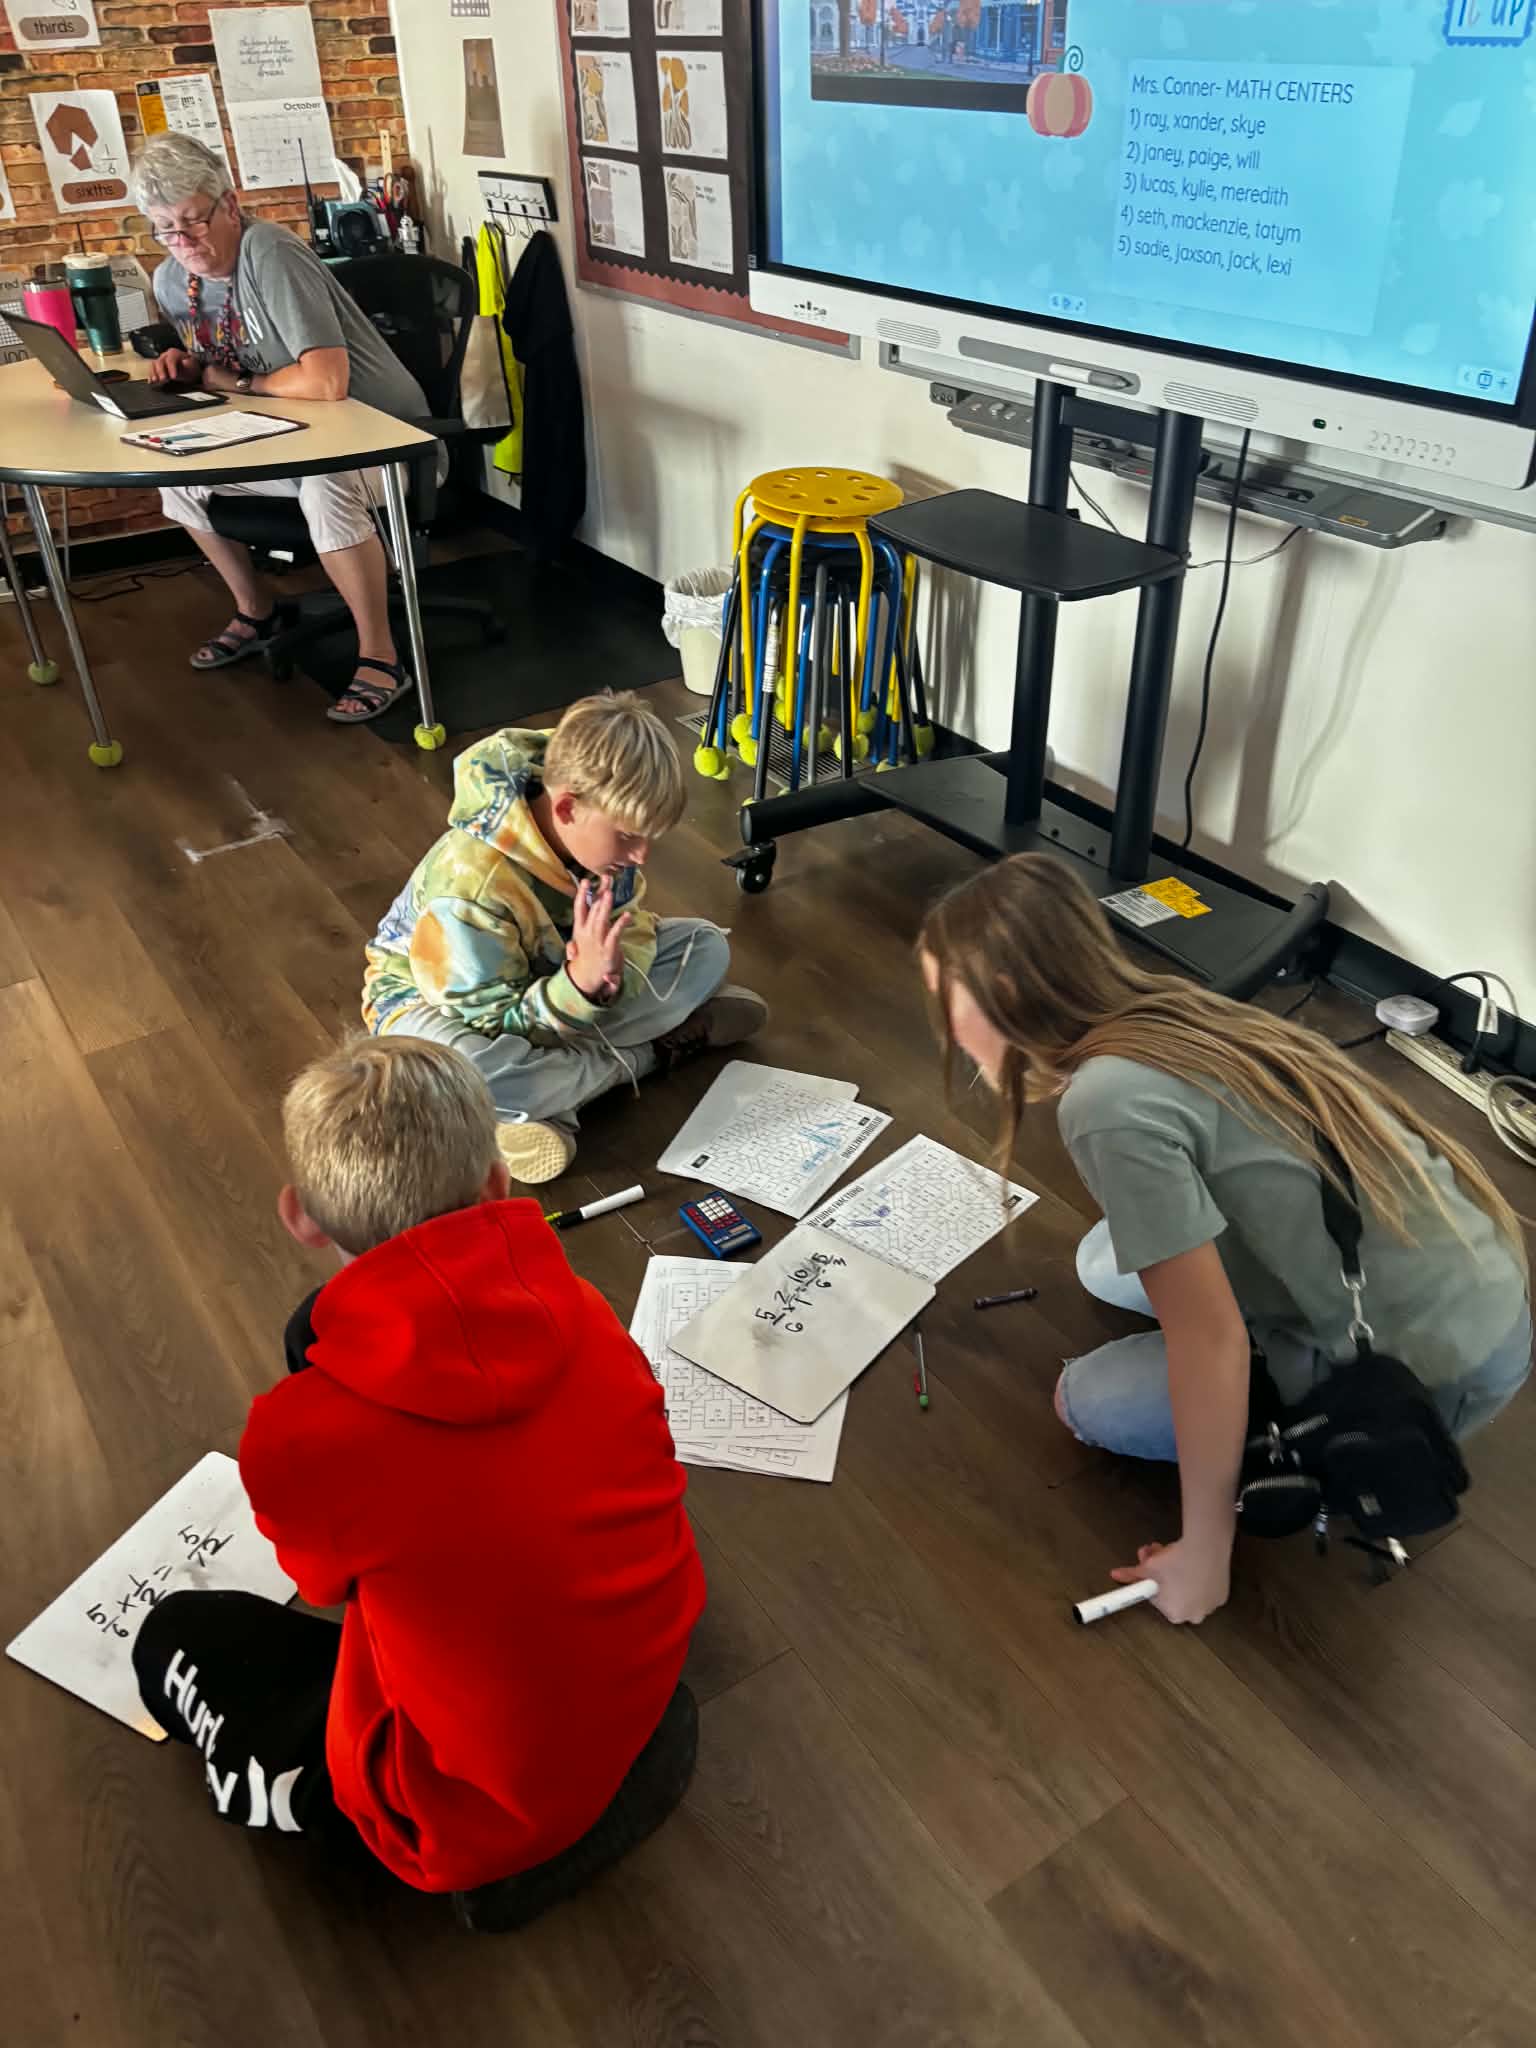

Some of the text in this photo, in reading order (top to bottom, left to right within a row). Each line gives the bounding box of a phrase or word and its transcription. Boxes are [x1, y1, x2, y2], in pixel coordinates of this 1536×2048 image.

[34, 19, 74, 34] thirds
[283, 101, 321, 112] October
[1226, 79, 1272, 100] MATH
[1276, 81, 1354, 104] CENTERS
[1130, 108, 1266, 139] 1) ray, xander, skye
[1126, 141, 1261, 171] 2) janey, paige, will
[76, 184, 114, 199] sixths
[1123, 172, 1289, 206] 3) lucas, kylie, meredith
[1121, 205, 1301, 246] 4) seth, mackenzie, tatym
[1118, 235, 1292, 276] 5) sadie, jaxson, jack, lexi
